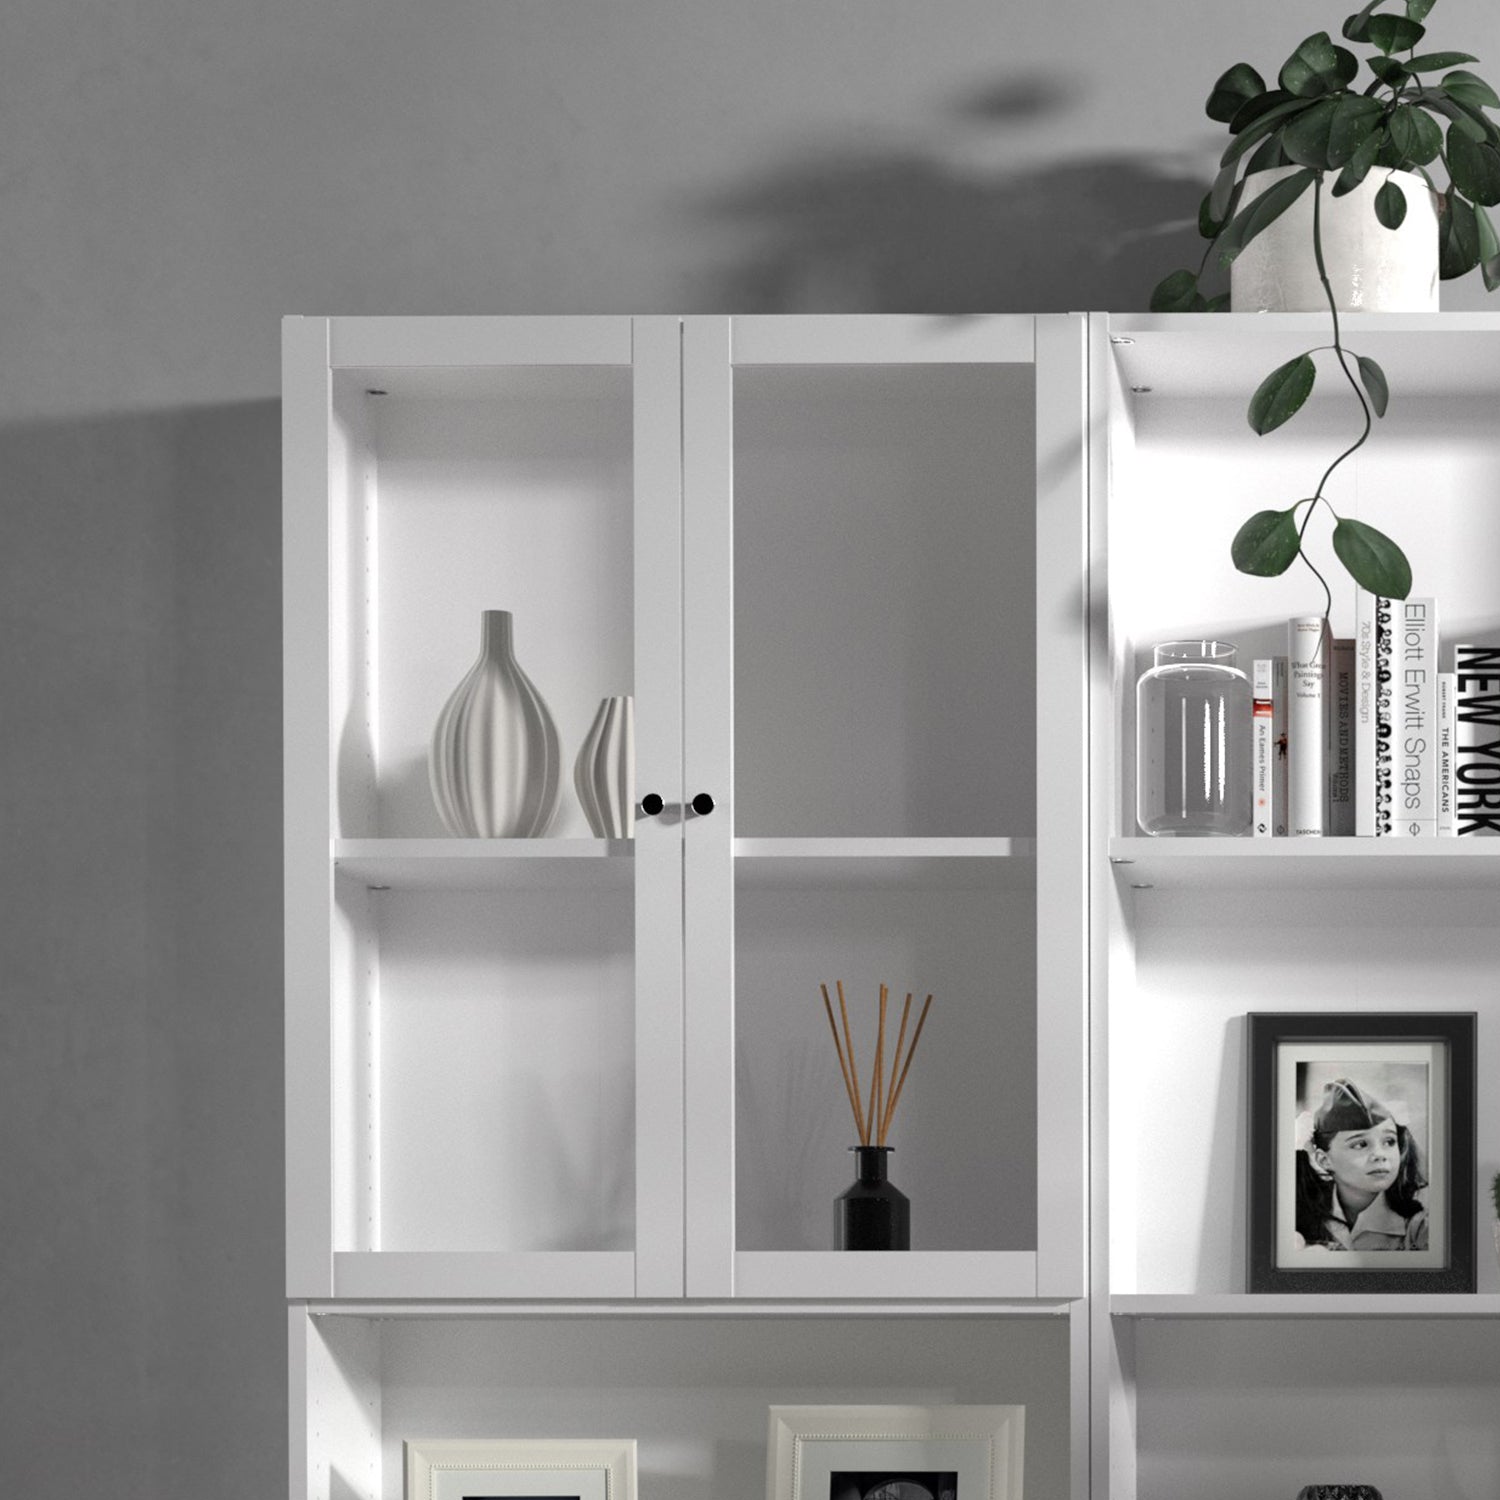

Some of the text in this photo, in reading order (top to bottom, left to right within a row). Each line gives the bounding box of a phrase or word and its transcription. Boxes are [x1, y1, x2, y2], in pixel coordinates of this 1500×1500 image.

[1302, 680, 1315, 689] Say
[1360, 621, 1371, 723] 70s Style & Design
[1400, 603, 1426, 810] Elliott Erwitt Snaps
[1259, 725, 1265, 736] An
[1339, 672, 1349, 802] MOVIES AND METHODS
